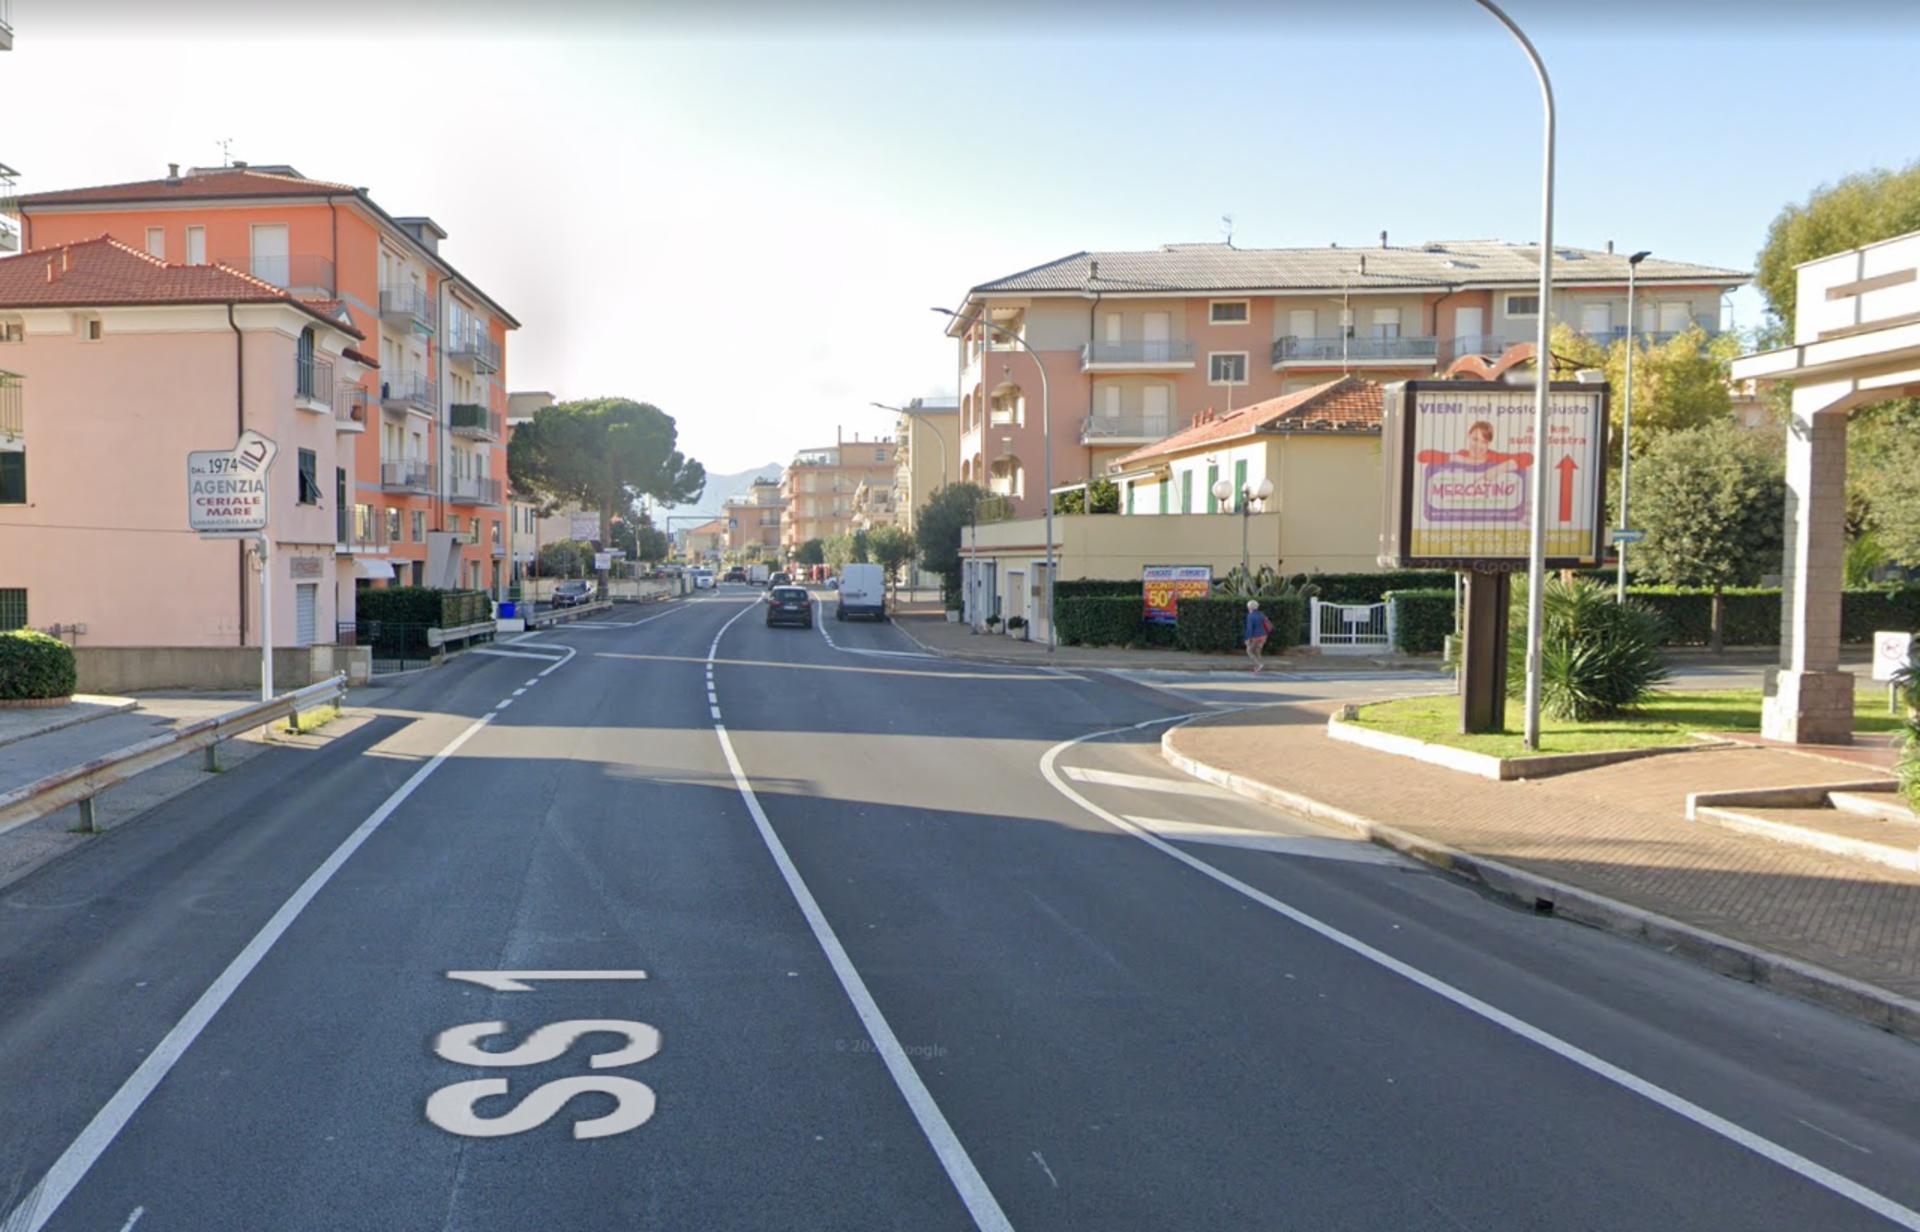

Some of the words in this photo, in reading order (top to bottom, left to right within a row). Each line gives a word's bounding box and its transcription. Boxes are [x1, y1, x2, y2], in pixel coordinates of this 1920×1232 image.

[1419, 403, 1462, 414] VIENI
[1468, 403, 1492, 414] nel
[1550, 424, 1570, 434] km
[209, 458, 238, 473] 1974
[193, 479, 264, 494] AGENZIA
[1431, 481, 1515, 498] MERCATINO
[196, 496, 261, 506] CERIALE
[206, 507, 252, 516] MARE
